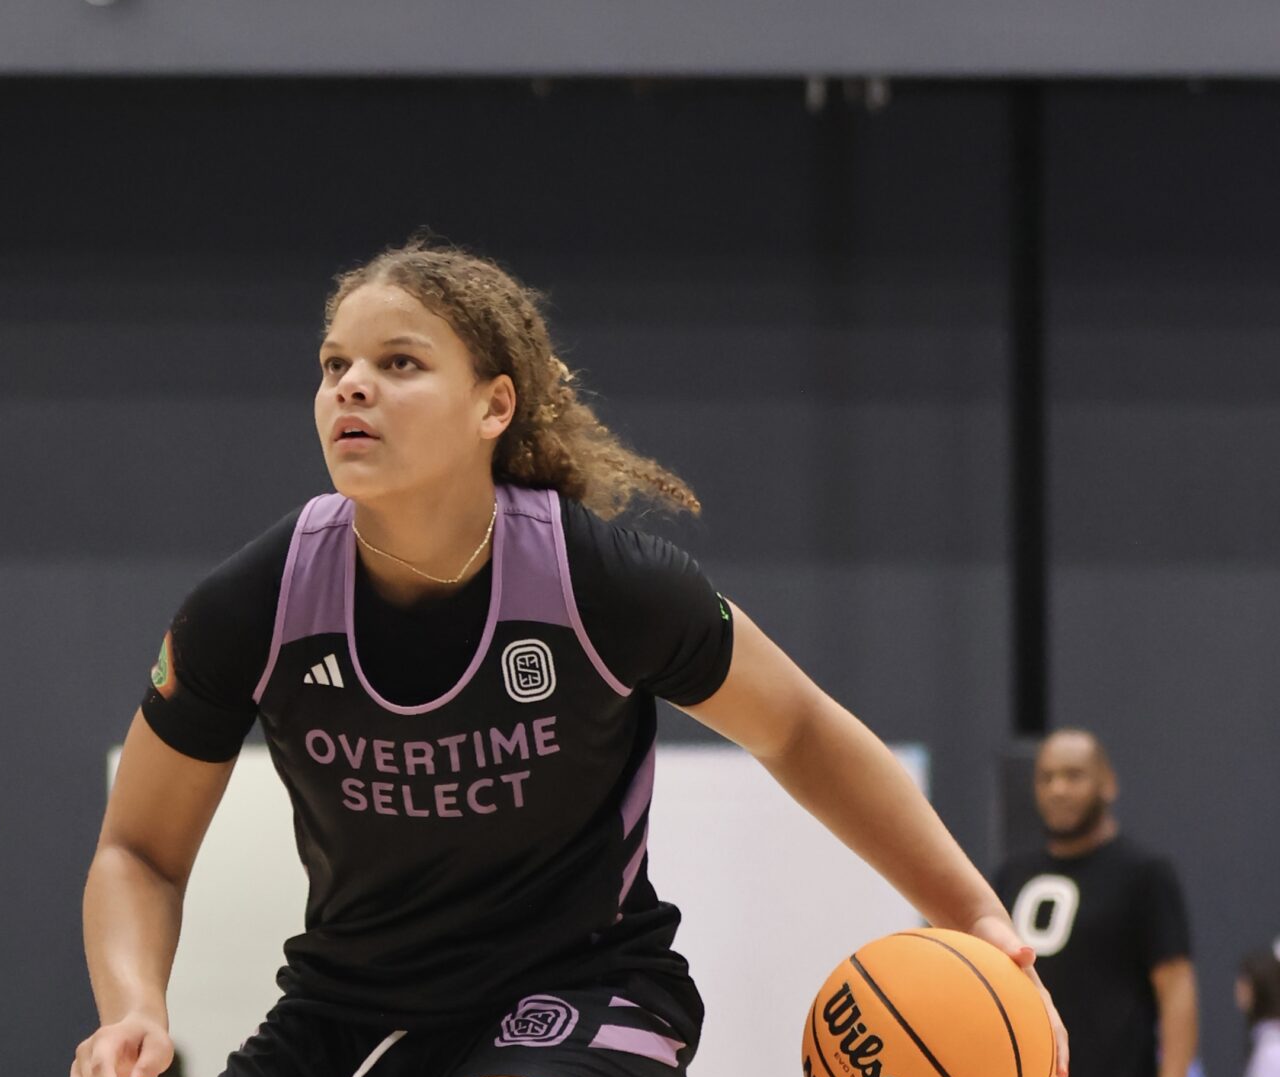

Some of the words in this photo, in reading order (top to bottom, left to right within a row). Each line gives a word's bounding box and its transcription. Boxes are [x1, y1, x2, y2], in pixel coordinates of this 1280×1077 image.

[305, 716, 560, 775] OVERTIME
[341, 770, 531, 818] SELECT
[834, 1052, 850, 1073] EVO
